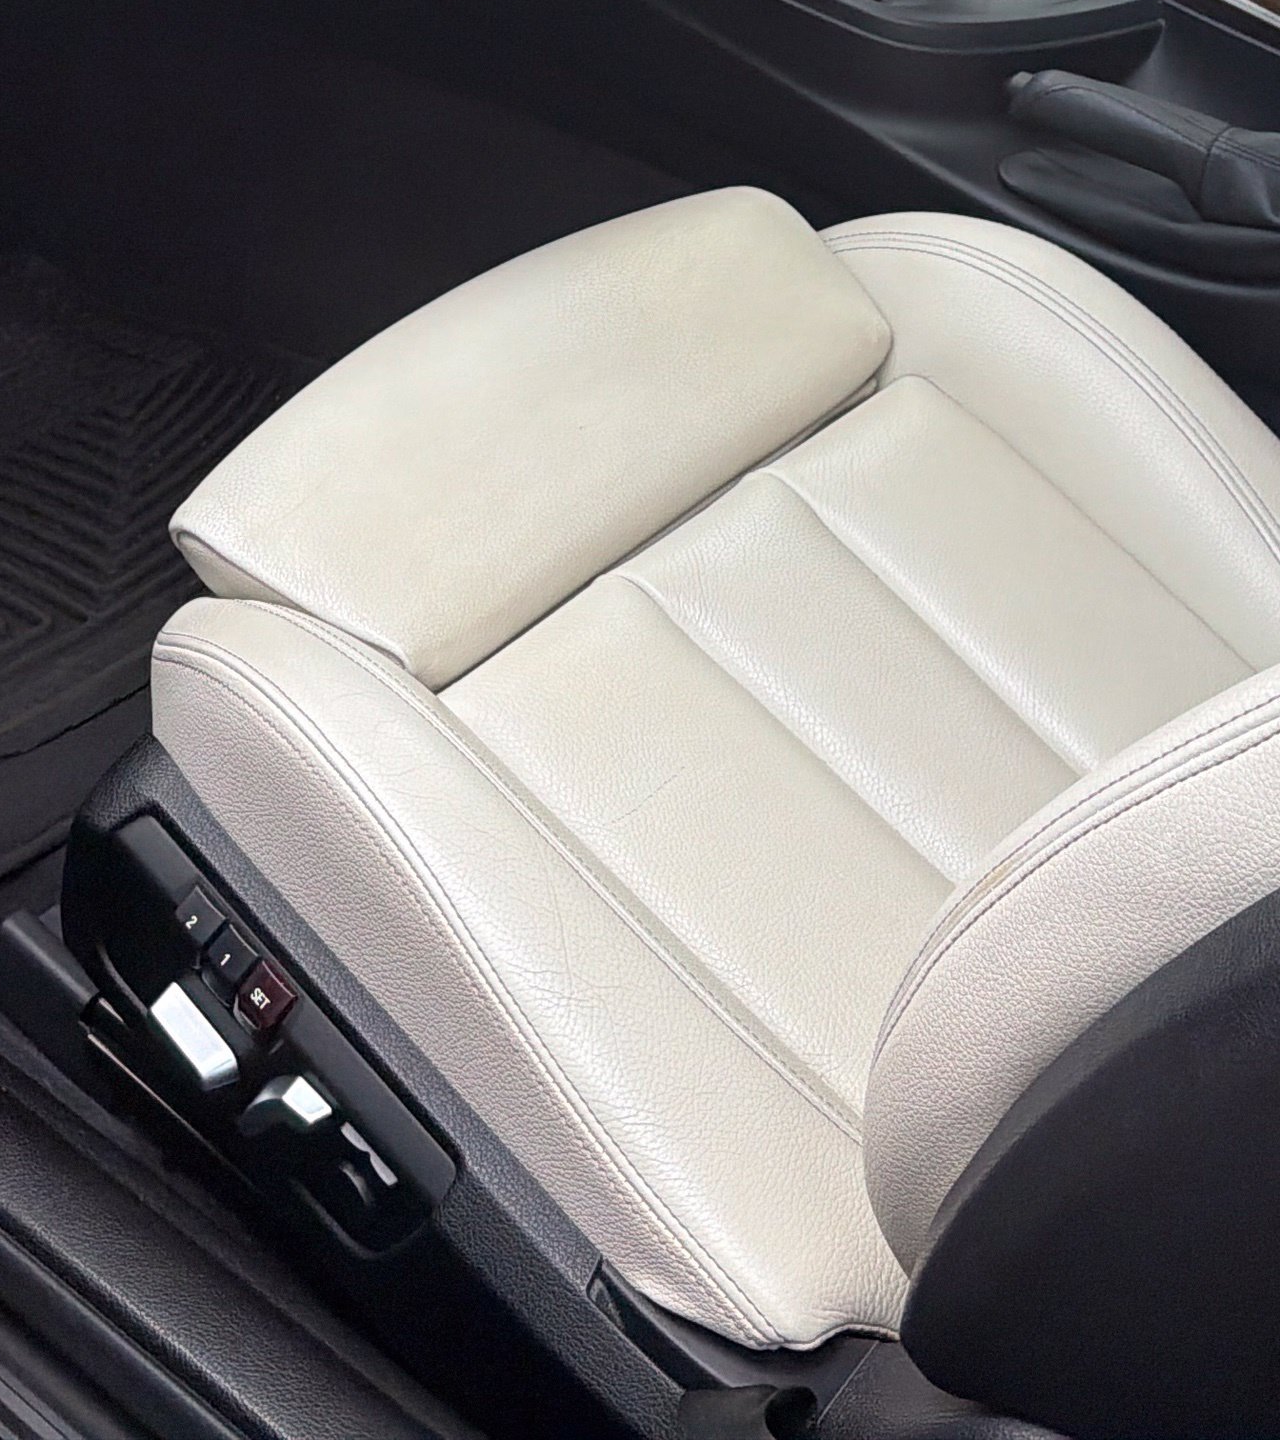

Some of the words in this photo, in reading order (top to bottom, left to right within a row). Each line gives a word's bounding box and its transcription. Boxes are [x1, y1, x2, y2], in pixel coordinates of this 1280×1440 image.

[185, 915, 198, 930] 2
[220, 953, 231, 967] 1
[250, 987, 272, 1010] SET
